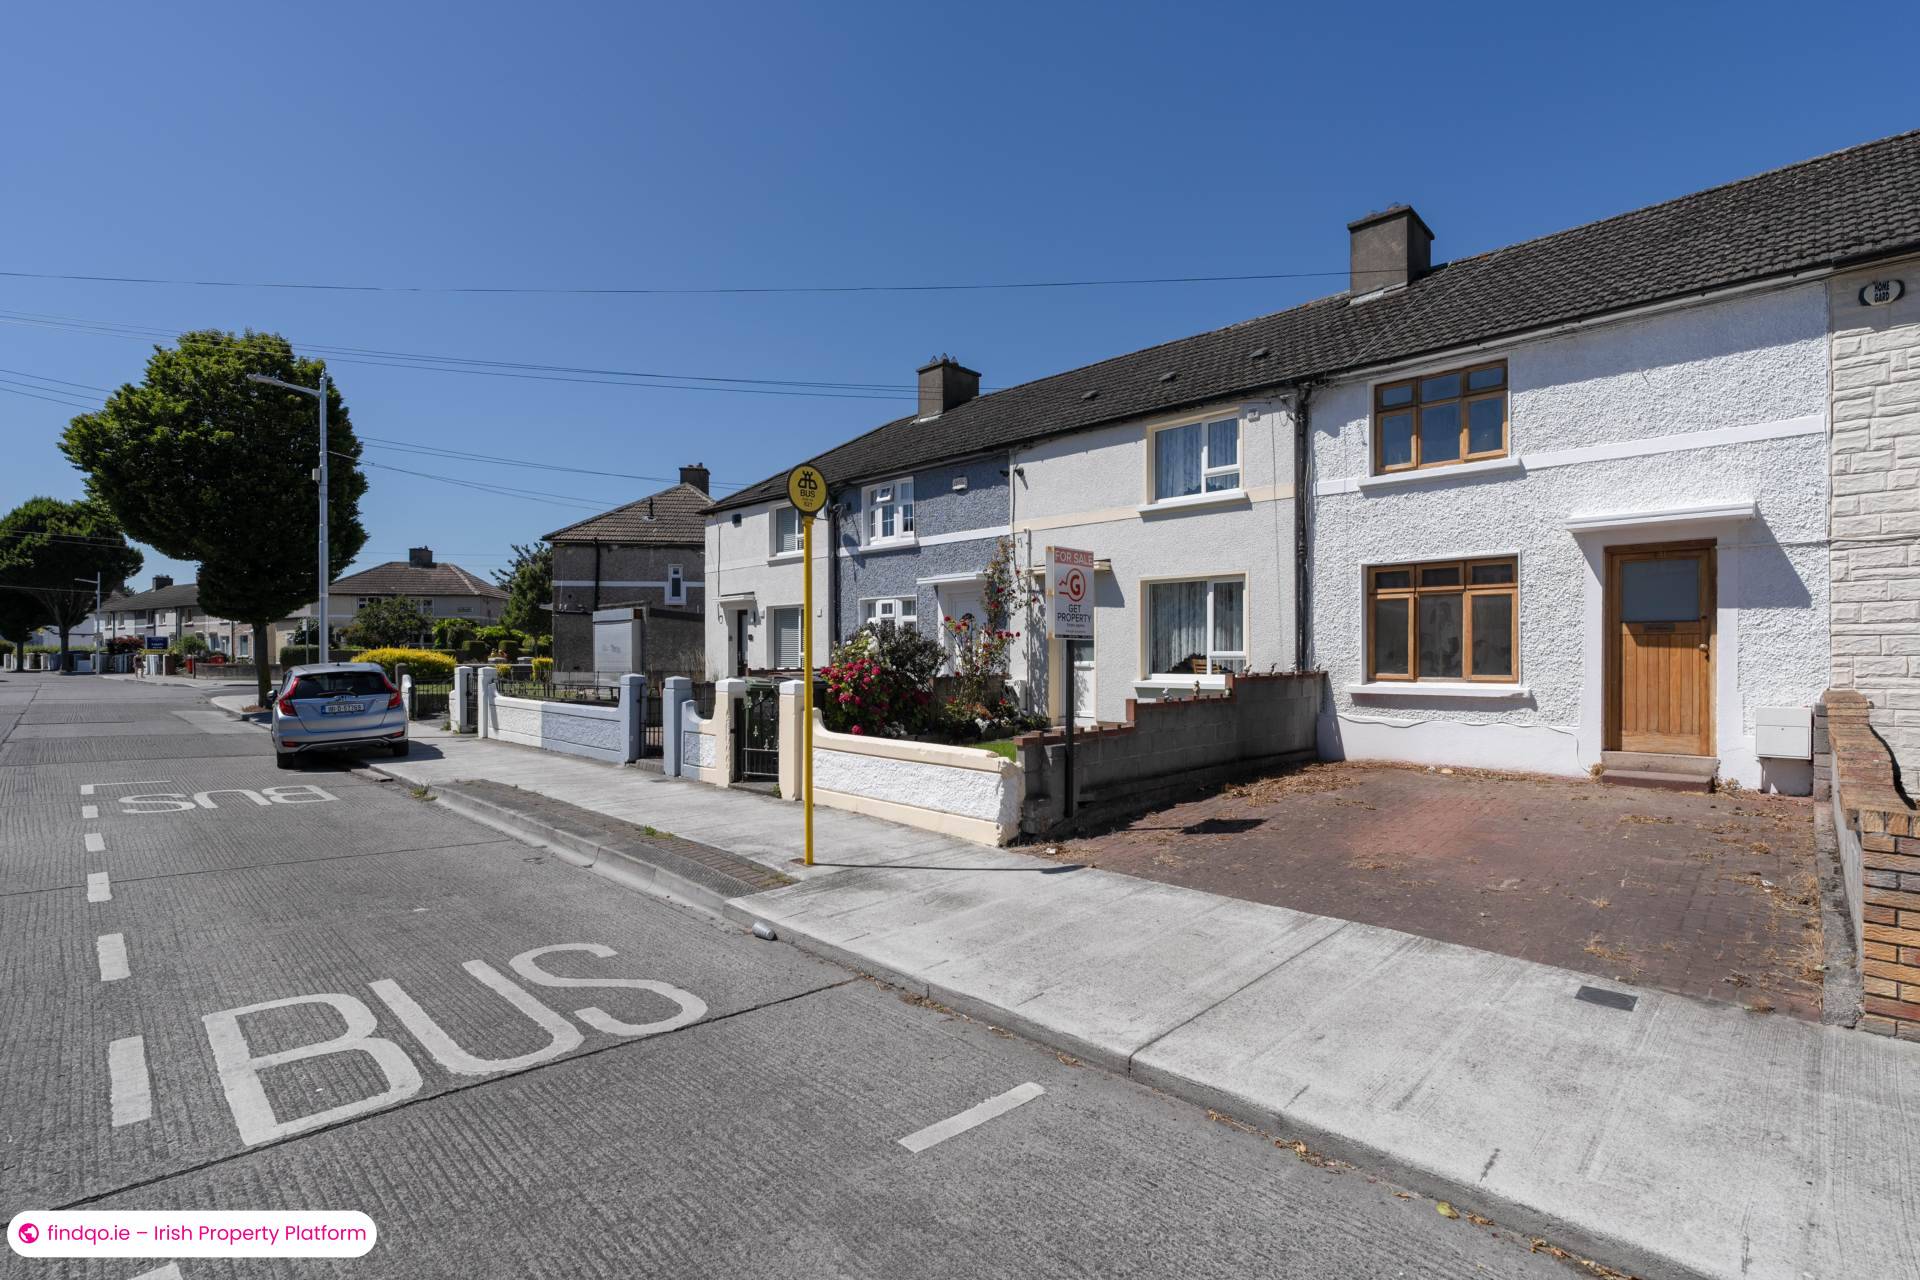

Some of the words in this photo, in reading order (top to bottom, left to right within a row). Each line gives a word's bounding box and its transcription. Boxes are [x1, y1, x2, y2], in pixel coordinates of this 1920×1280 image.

[1874, 280, 1889, 291] HOME
[800, 489, 815, 497] BUS
[1055, 550, 1072, 563] FOR
[1073, 552, 1093, 566] SALE
[1070, 575, 1081, 595] G
[1068, 604, 1082, 613] GET
[1056, 612, 1092, 623] PROPERTY
[118, 784, 340, 814] BUS
[201, 943, 709, 1147] BUS
